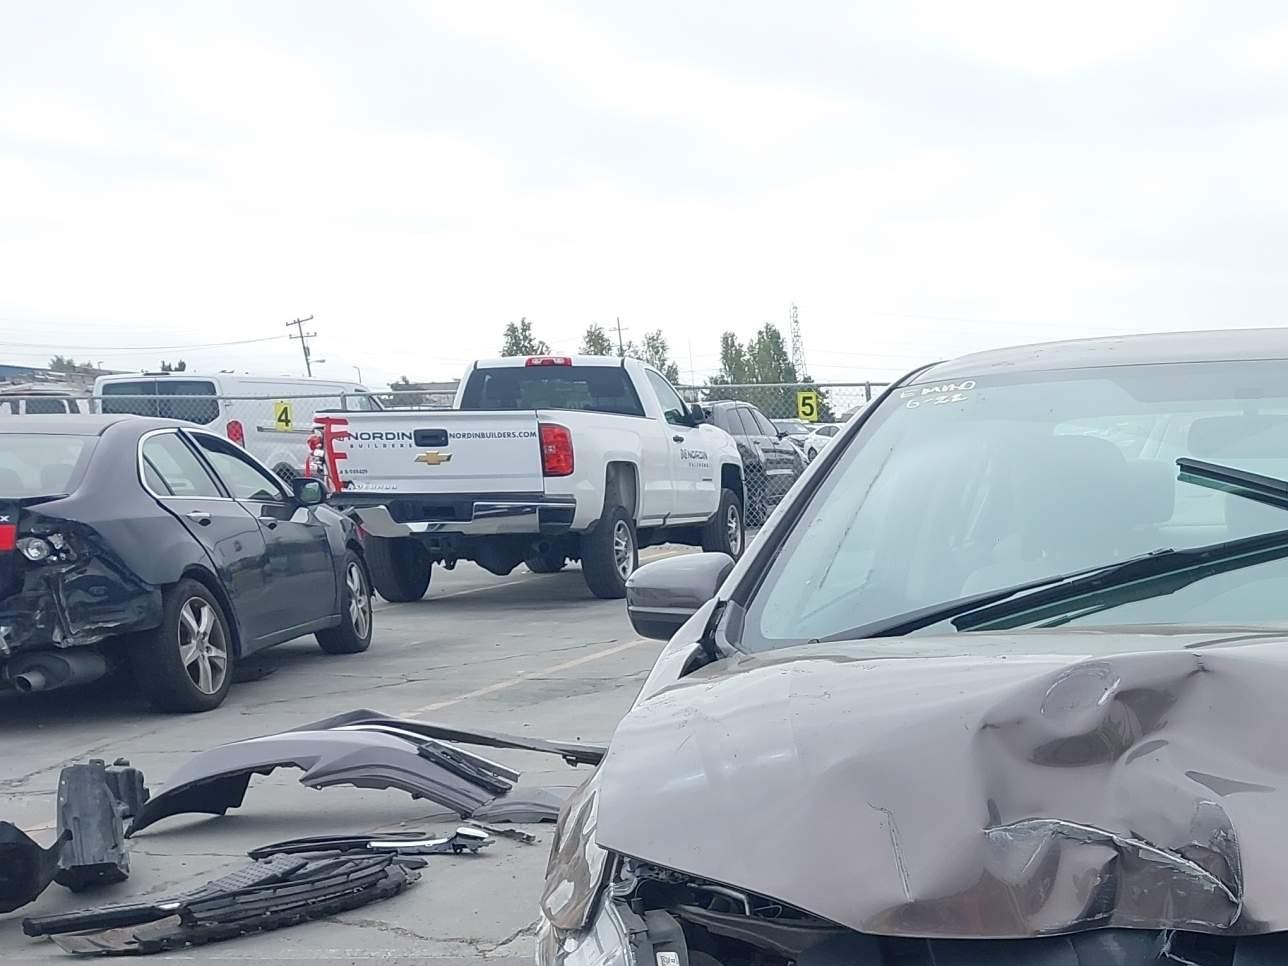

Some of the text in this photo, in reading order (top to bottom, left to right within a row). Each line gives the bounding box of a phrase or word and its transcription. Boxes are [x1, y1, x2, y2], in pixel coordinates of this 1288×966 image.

[801, 396, 814, 417] 5
[277, 406, 291, 427] 4
[346, 431, 412, 441] NORDIN
[449, 431, 537, 439] NORDINBUILDERS.COM
